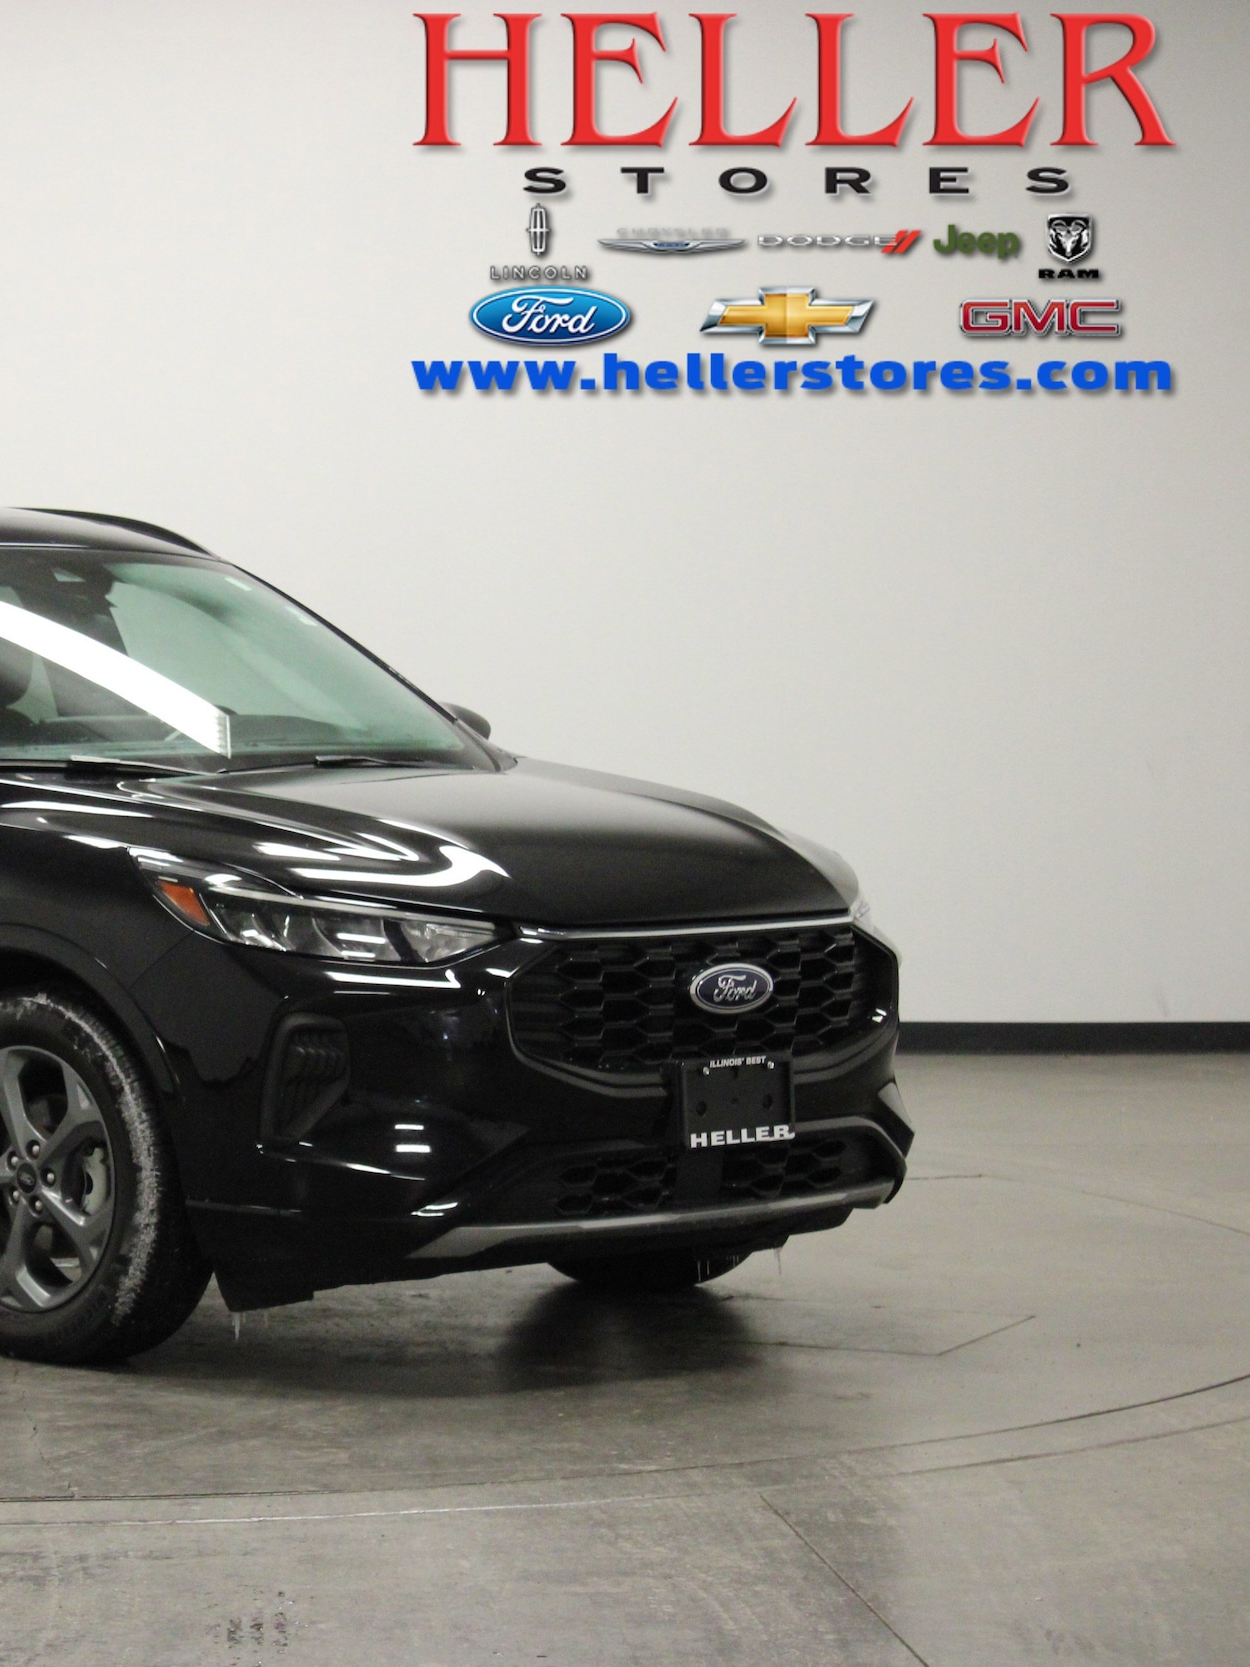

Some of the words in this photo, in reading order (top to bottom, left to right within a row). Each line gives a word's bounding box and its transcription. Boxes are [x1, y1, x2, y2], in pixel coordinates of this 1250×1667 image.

[712, 974, 758, 1003] Ford
[745, 1055, 767, 1066] BEST
[690, 1123, 796, 1149] HELLER
